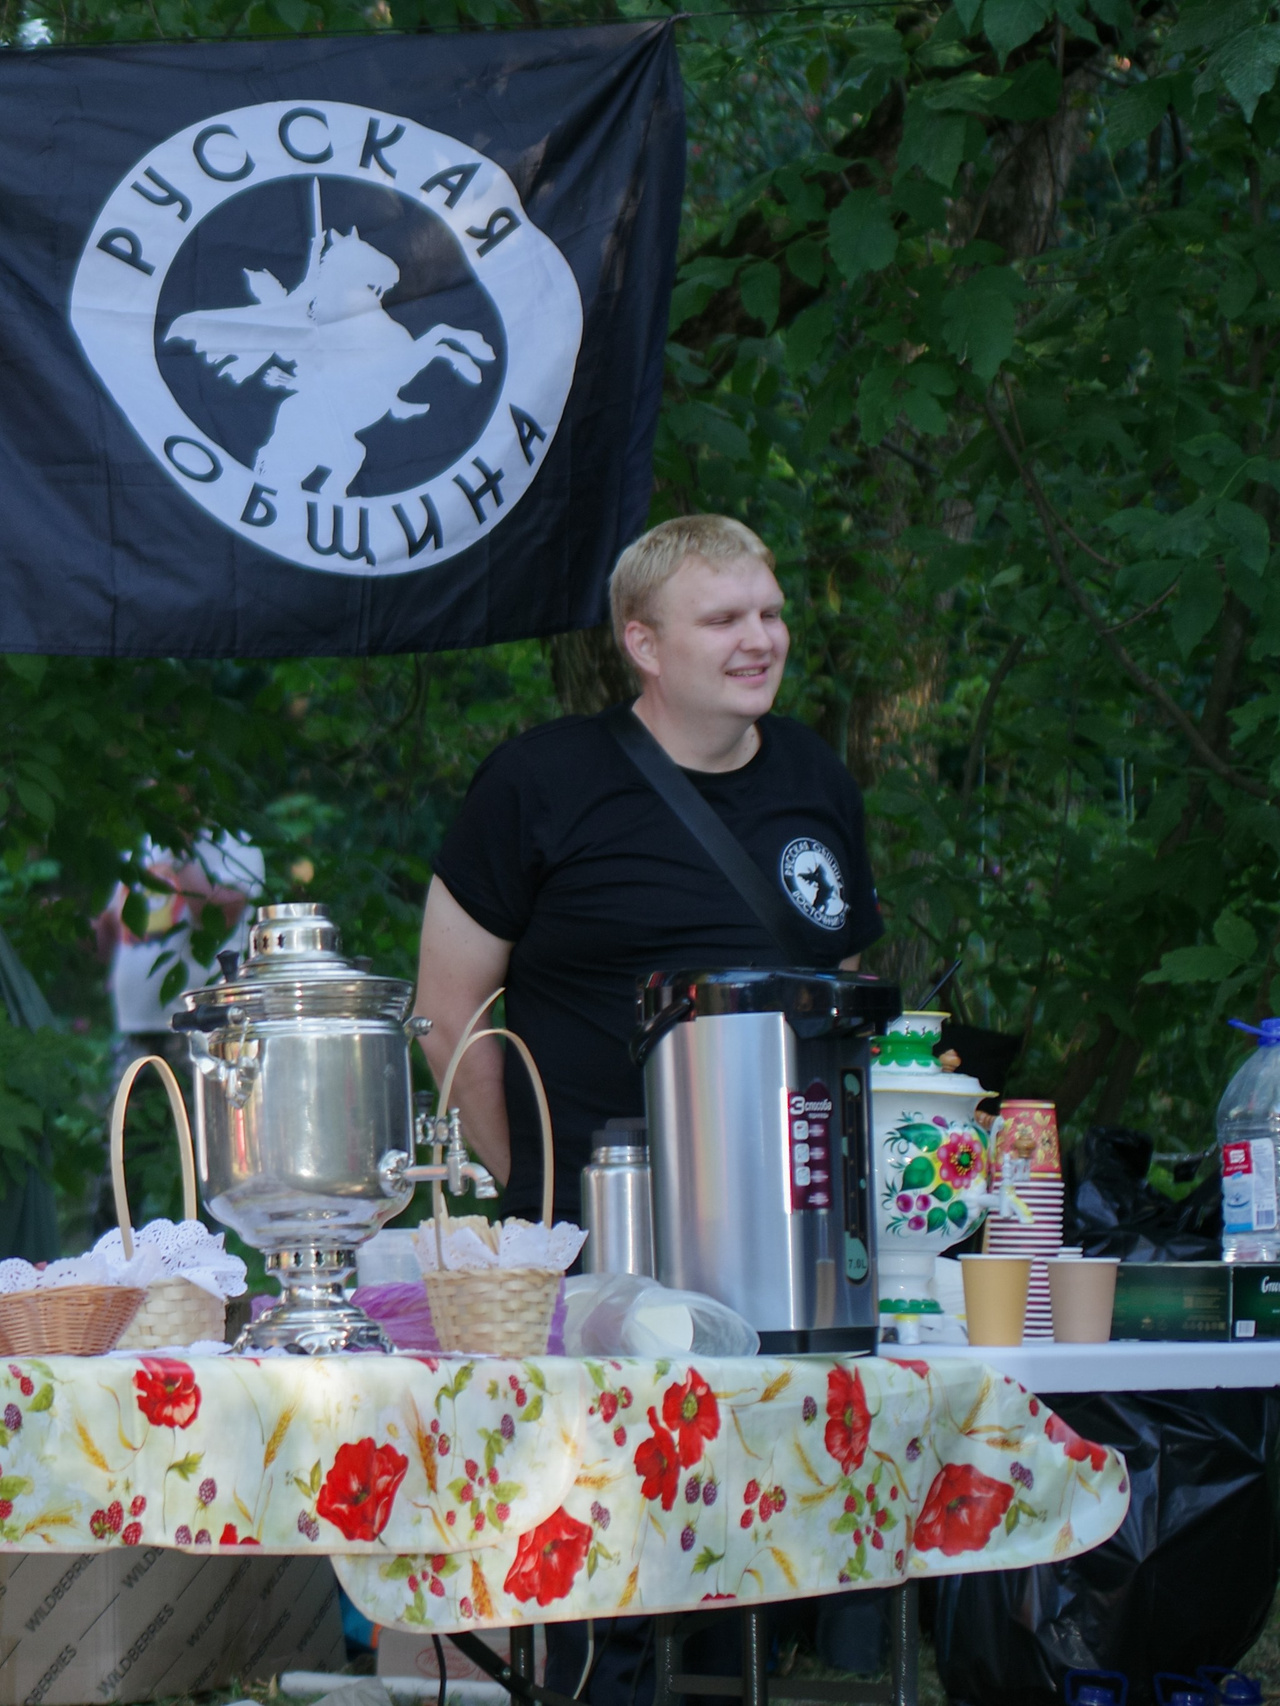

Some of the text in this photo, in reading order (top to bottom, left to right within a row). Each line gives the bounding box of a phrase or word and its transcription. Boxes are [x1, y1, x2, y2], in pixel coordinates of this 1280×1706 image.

[96, 107, 522, 277] РУССКАЯ
[163, 403, 548, 566] ОБЩИНА
[790, 1096, 832, 1115] 3 способа
[848, 1258, 867, 1269] 7.0L
[97, 1604, 174, 1696] WILDBERRIES
